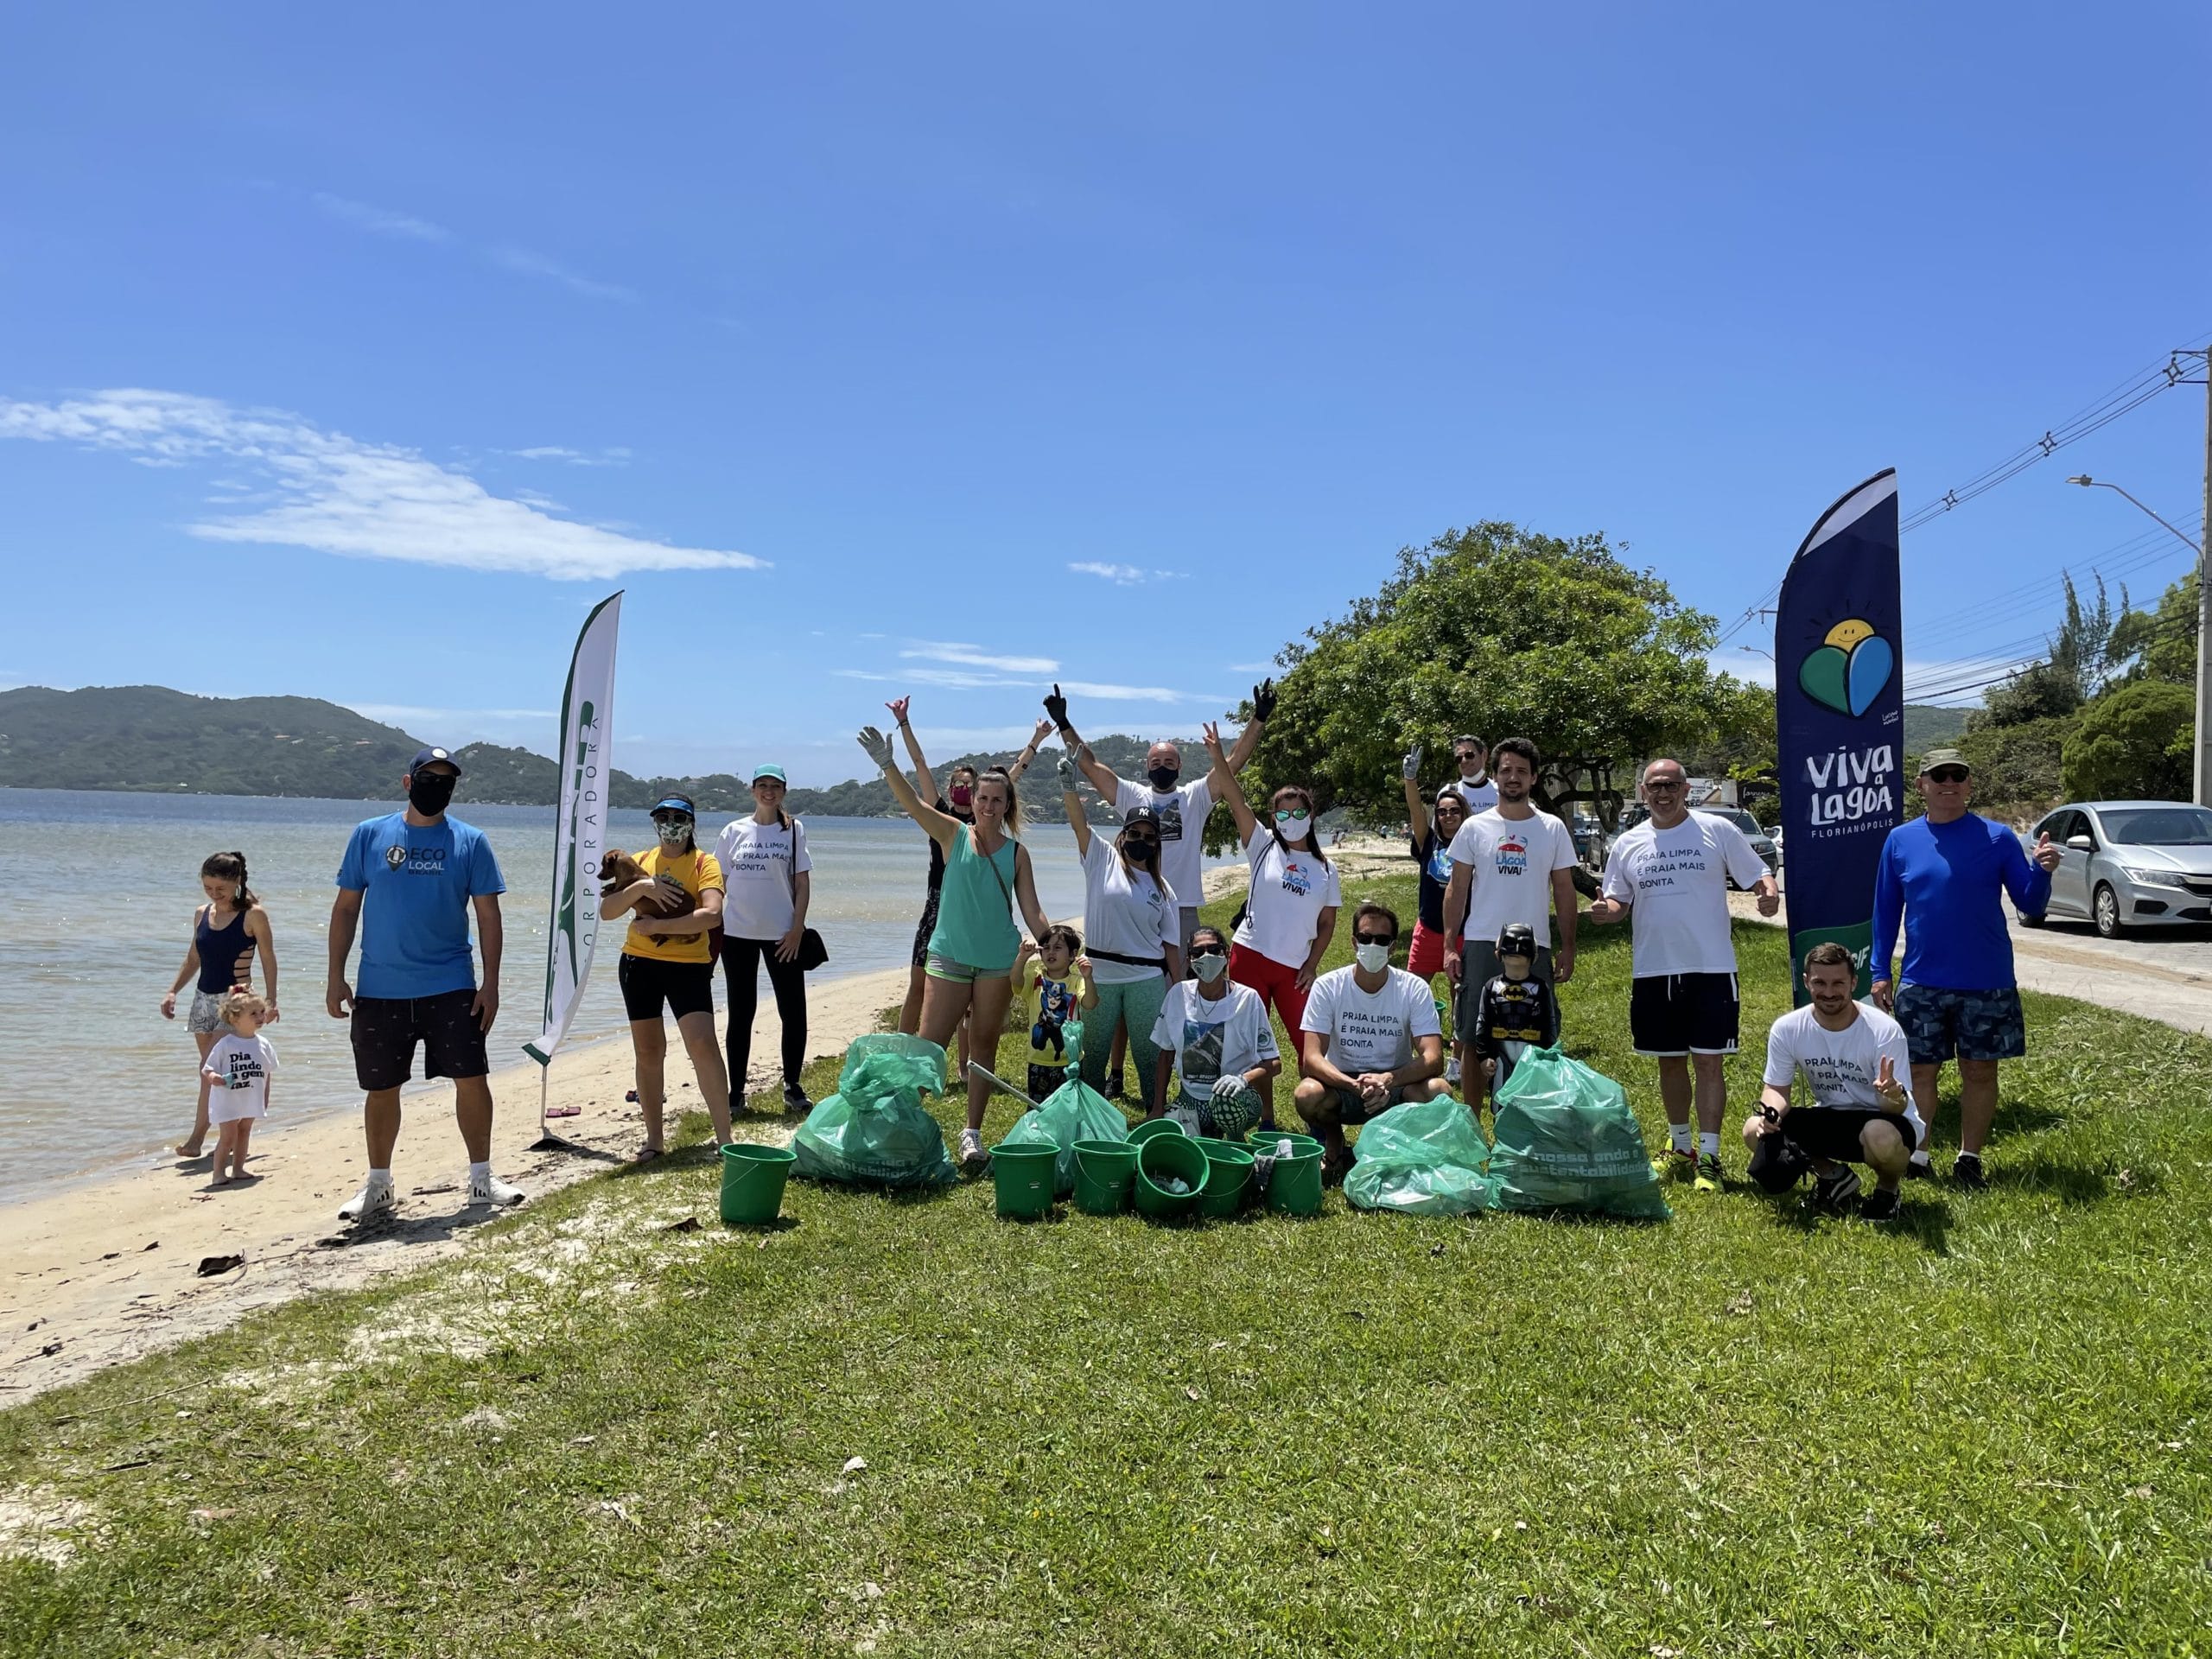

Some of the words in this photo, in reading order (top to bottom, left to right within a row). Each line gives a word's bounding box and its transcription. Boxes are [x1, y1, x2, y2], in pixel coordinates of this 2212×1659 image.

[1811, 817, 1894, 838] FLORIANÓPOLIS
[582, 717, 599, 963] ORPORADORA
[410, 848, 446, 861] ECO
[1637, 851, 1667, 863] PRAIA
[1669, 849, 1702, 858] LIMPA
[409, 861, 445, 870] LOCAL
[1496, 856, 1527, 867] LAGOA
[1645, 864, 1676, 874] PRAIA
[1679, 862, 1706, 871] MAIS
[1281, 873, 1311, 890] LAGOA
[1639, 878, 1675, 889] BONITA
[1342, 1012, 1369, 1021] PRAIA
[1370, 1015, 1399, 1024] LIMPA
[1341, 1023, 1347, 1033] É
[1350, 1025, 1376, 1036] PRAIA
[1379, 1028, 1403, 1037] MAIS
[1340, 1038, 1374, 1048] BONITA
[230, 1052, 251, 1063] Dia
[1804, 1057, 1833, 1067] PRAI
[230, 1061, 262, 1072] lindo
[1594, 1148, 1630, 1162] onda
